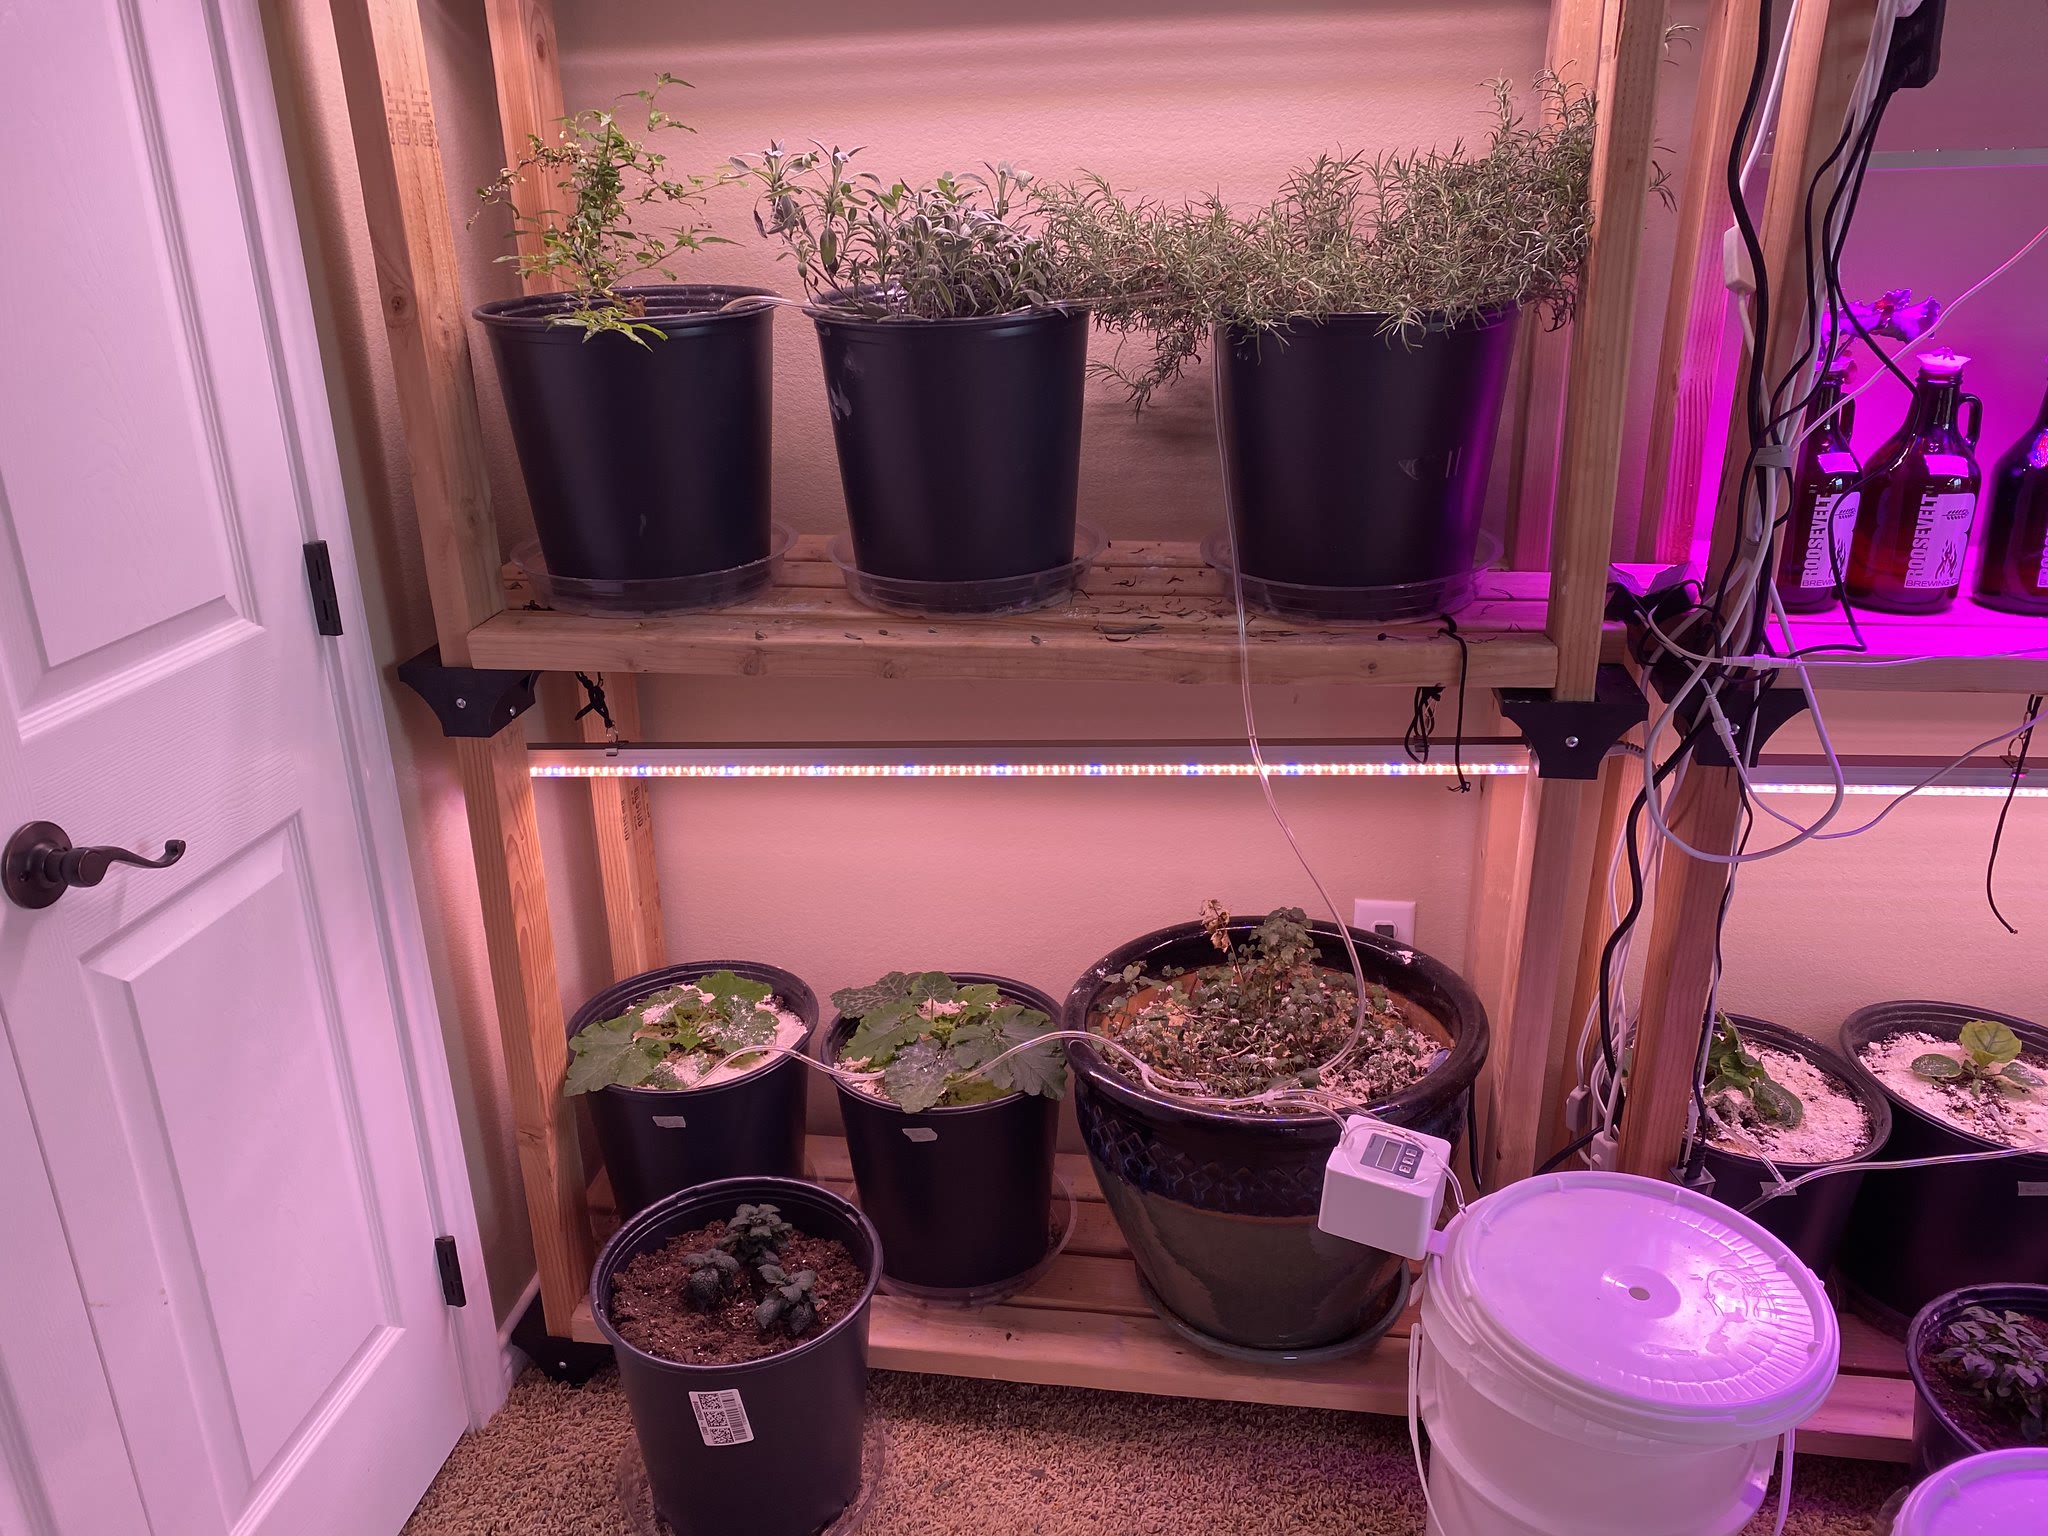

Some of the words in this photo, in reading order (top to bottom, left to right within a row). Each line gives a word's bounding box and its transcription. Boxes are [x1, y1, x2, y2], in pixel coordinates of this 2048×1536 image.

[1802, 494, 1832, 580] ROOSEVELT
[1906, 494, 1939, 580] ROOSEVELT
[1905, 578, 1950, 587] BREWING
